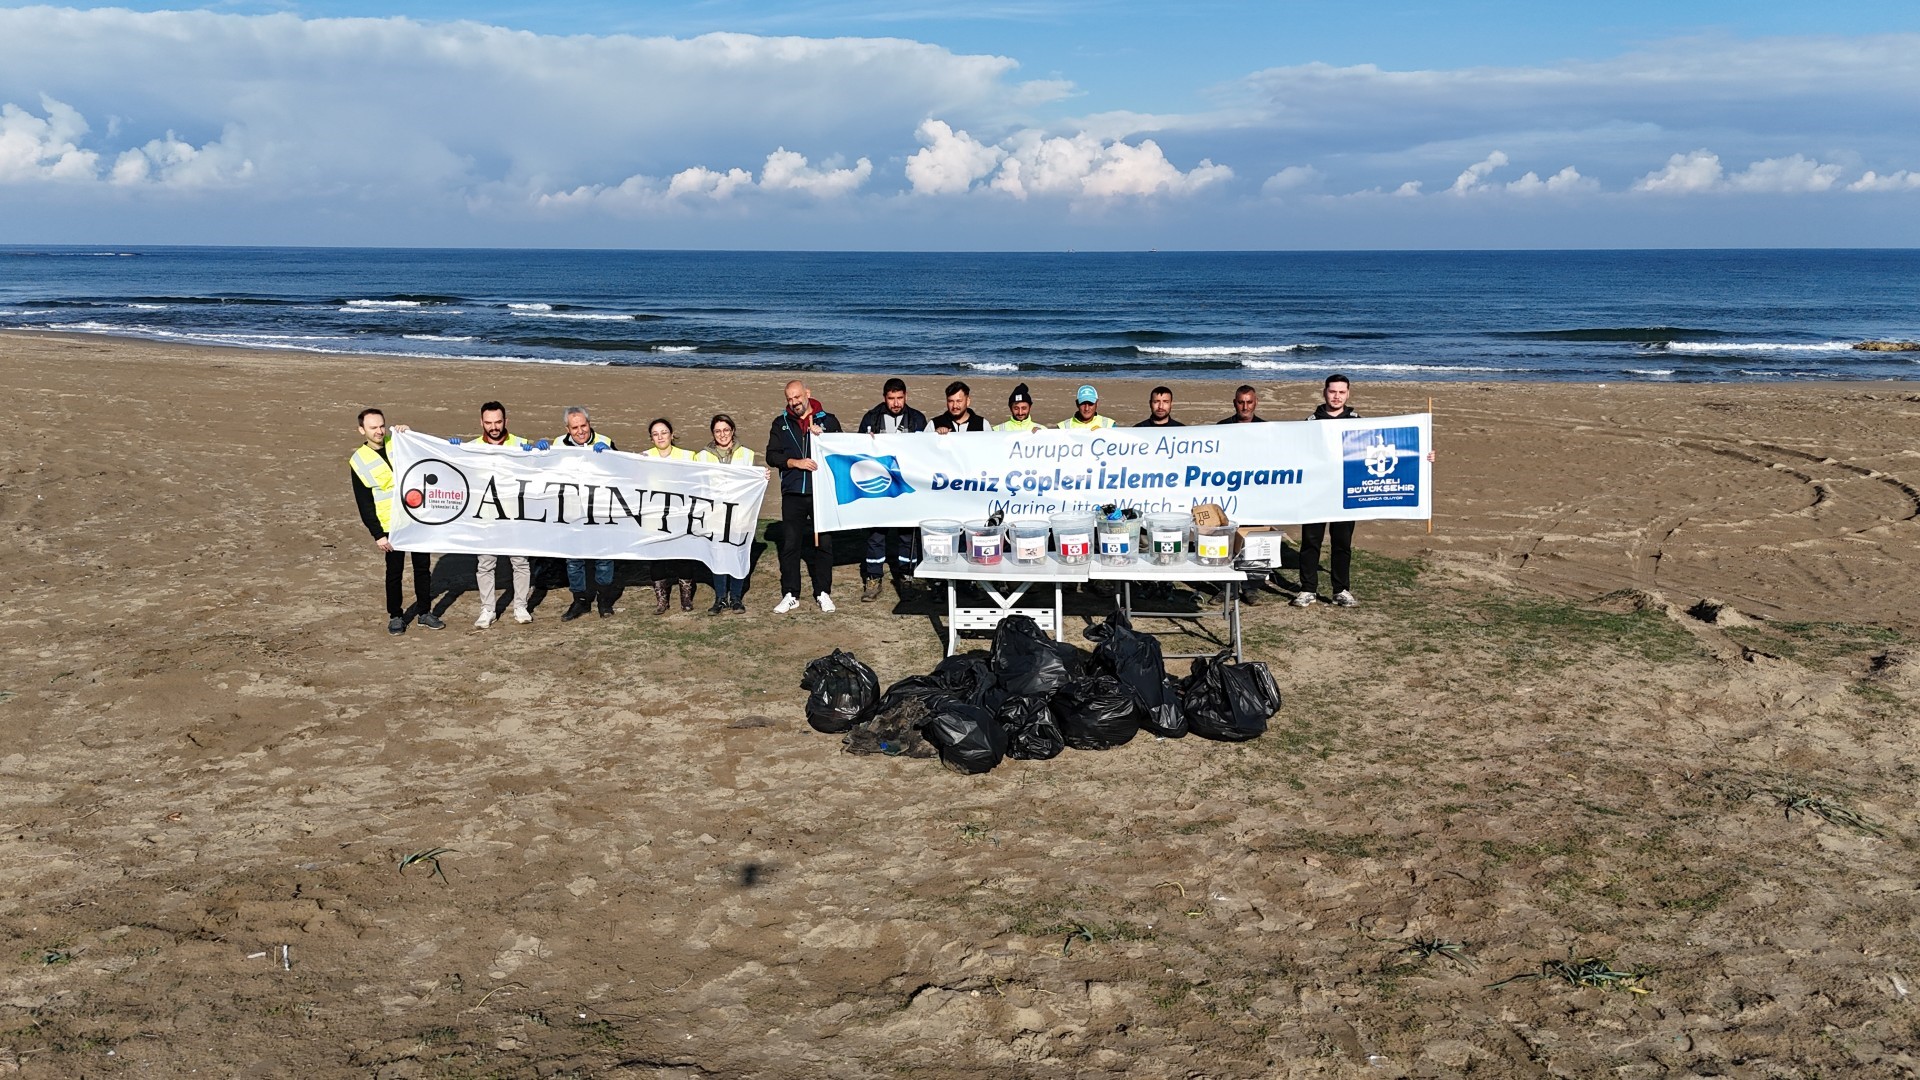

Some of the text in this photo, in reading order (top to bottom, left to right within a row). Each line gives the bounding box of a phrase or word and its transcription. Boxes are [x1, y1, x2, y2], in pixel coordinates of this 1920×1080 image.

[1009, 436, 1219, 462] Avrupa Çevre Ajansı
[931, 461, 1303, 496] Deniz Çöpleri İzleme Programı
[1347, 485, 1415, 494] BÜYÜKŞEHİR
[472, 475, 749, 546] ALTINTEL
[988, 499, 1056, 516] (Marine
[1062, 500, 1101, 512] Litte
